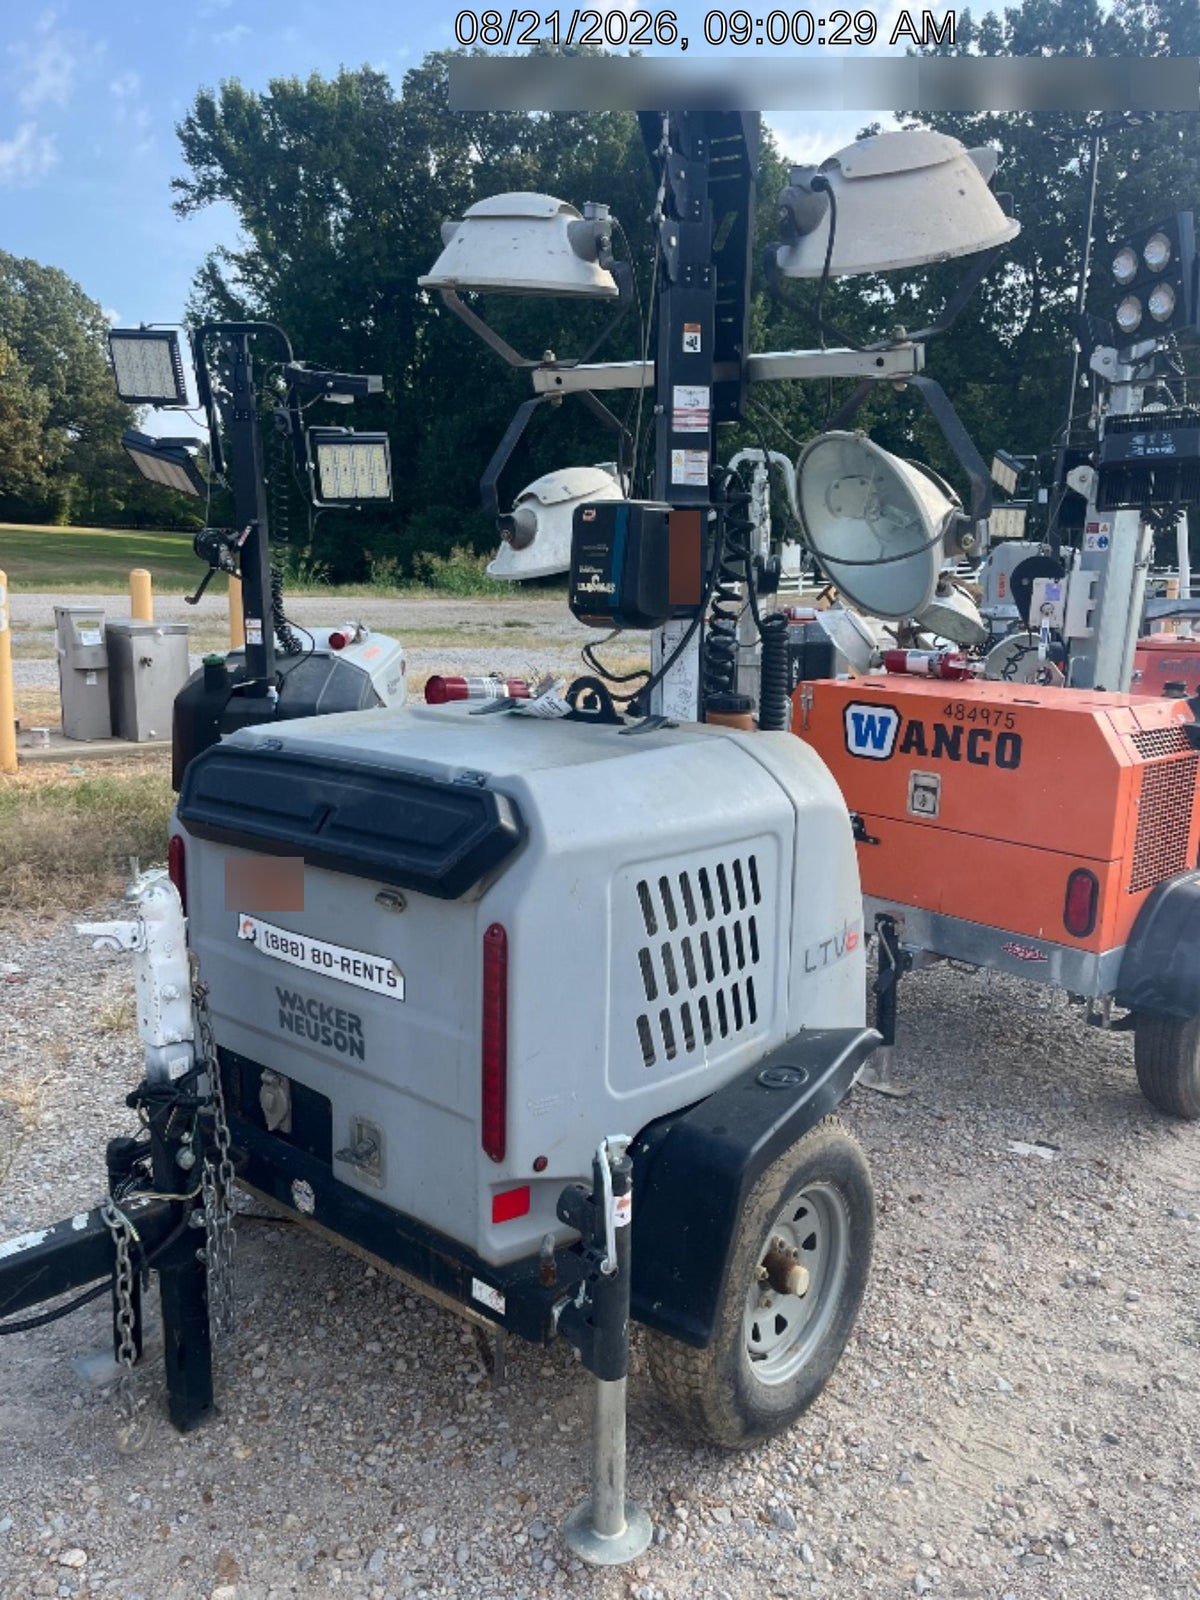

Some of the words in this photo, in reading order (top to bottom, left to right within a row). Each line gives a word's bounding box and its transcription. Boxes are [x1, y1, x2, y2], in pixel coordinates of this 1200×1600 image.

[849, 711, 1022, 769] WANCO
[943, 702, 1016, 730] 484975
[264, 930, 305, 960] (888)
[311, 947, 398, 988] 80-RENTS
[275, 985, 364, 1038] WACKER
[278, 1008, 365, 1061] NEUSON
